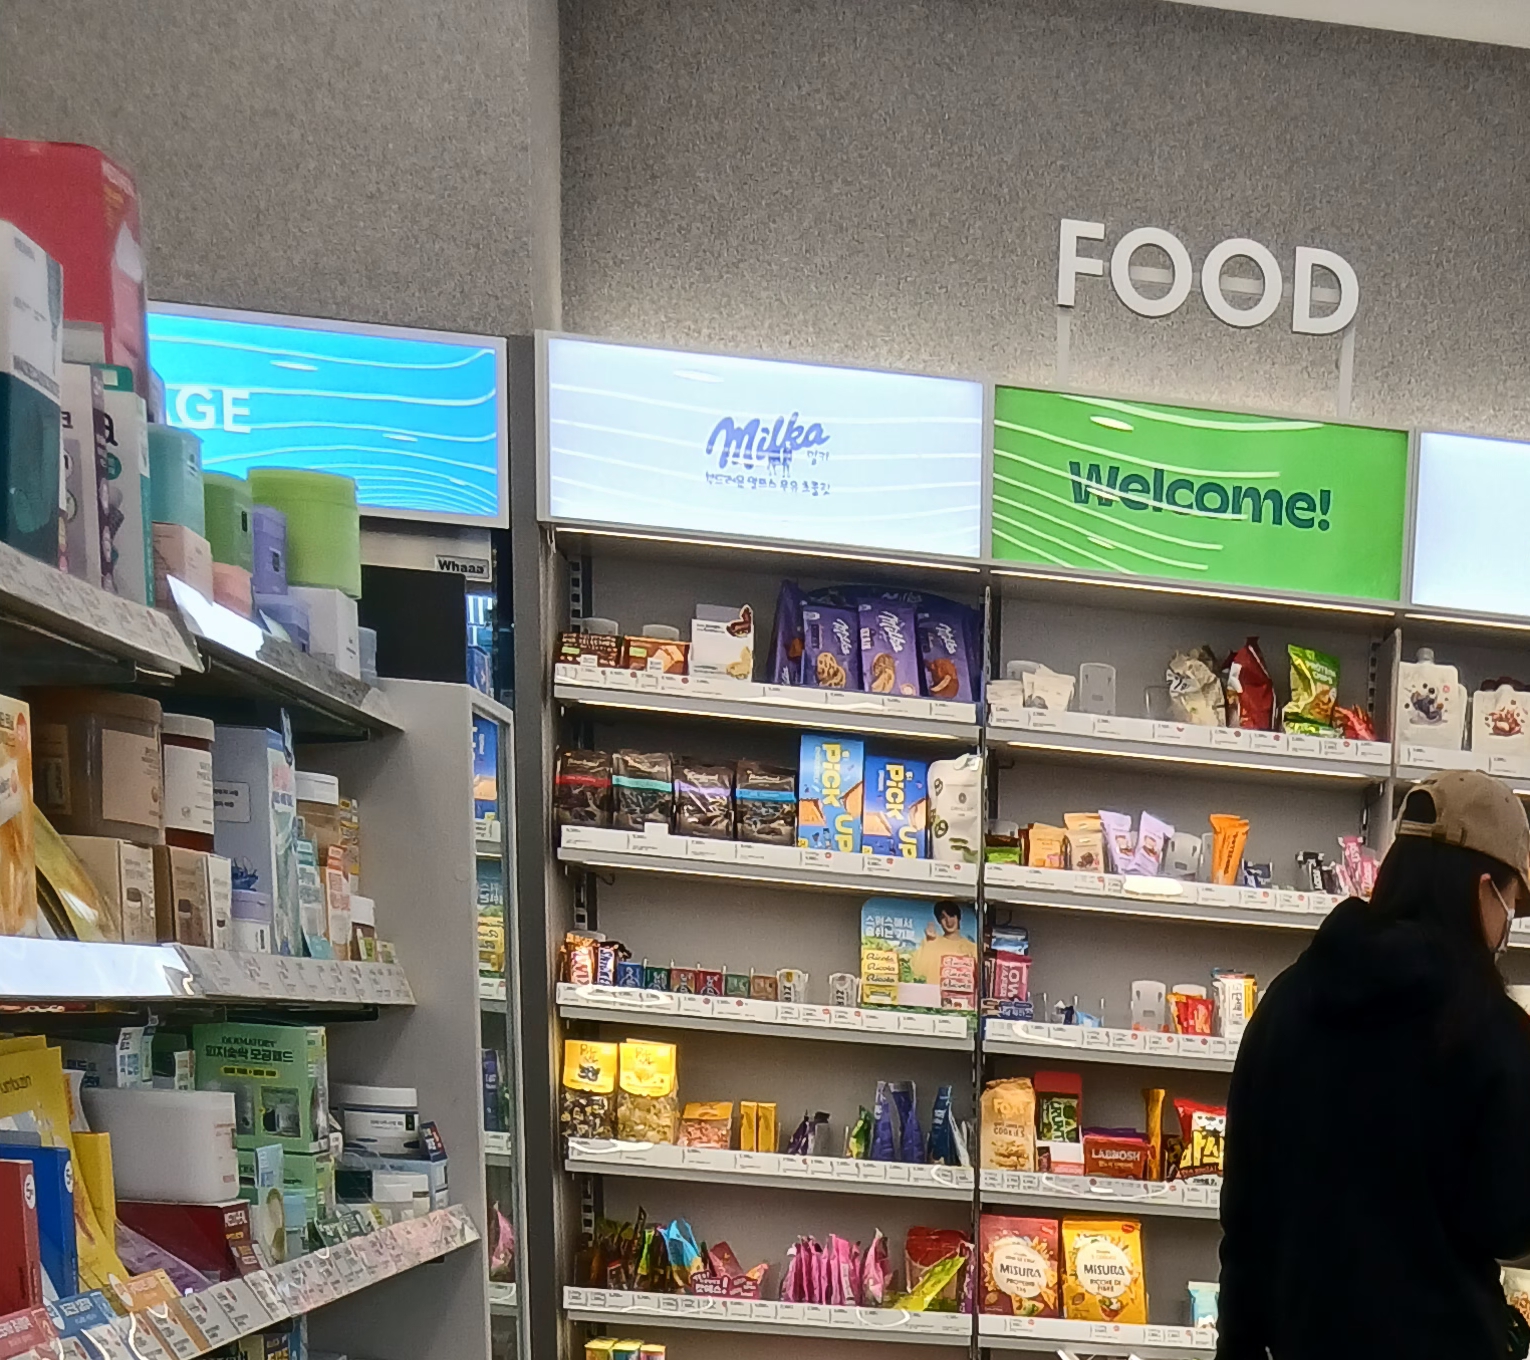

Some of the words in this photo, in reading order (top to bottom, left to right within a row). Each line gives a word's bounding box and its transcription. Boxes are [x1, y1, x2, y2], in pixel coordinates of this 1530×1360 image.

[1056, 219, 1359, 335] FOOD
[166, 385, 251, 434] GE
[705, 411, 831, 470] Milka
[780, 479, 799, 493] 우유
[1068, 460, 1332, 532] Welcome!
[1000, 1264, 1042, 1279] MISURA
[1083, 1263, 1125, 1277] MISURA
